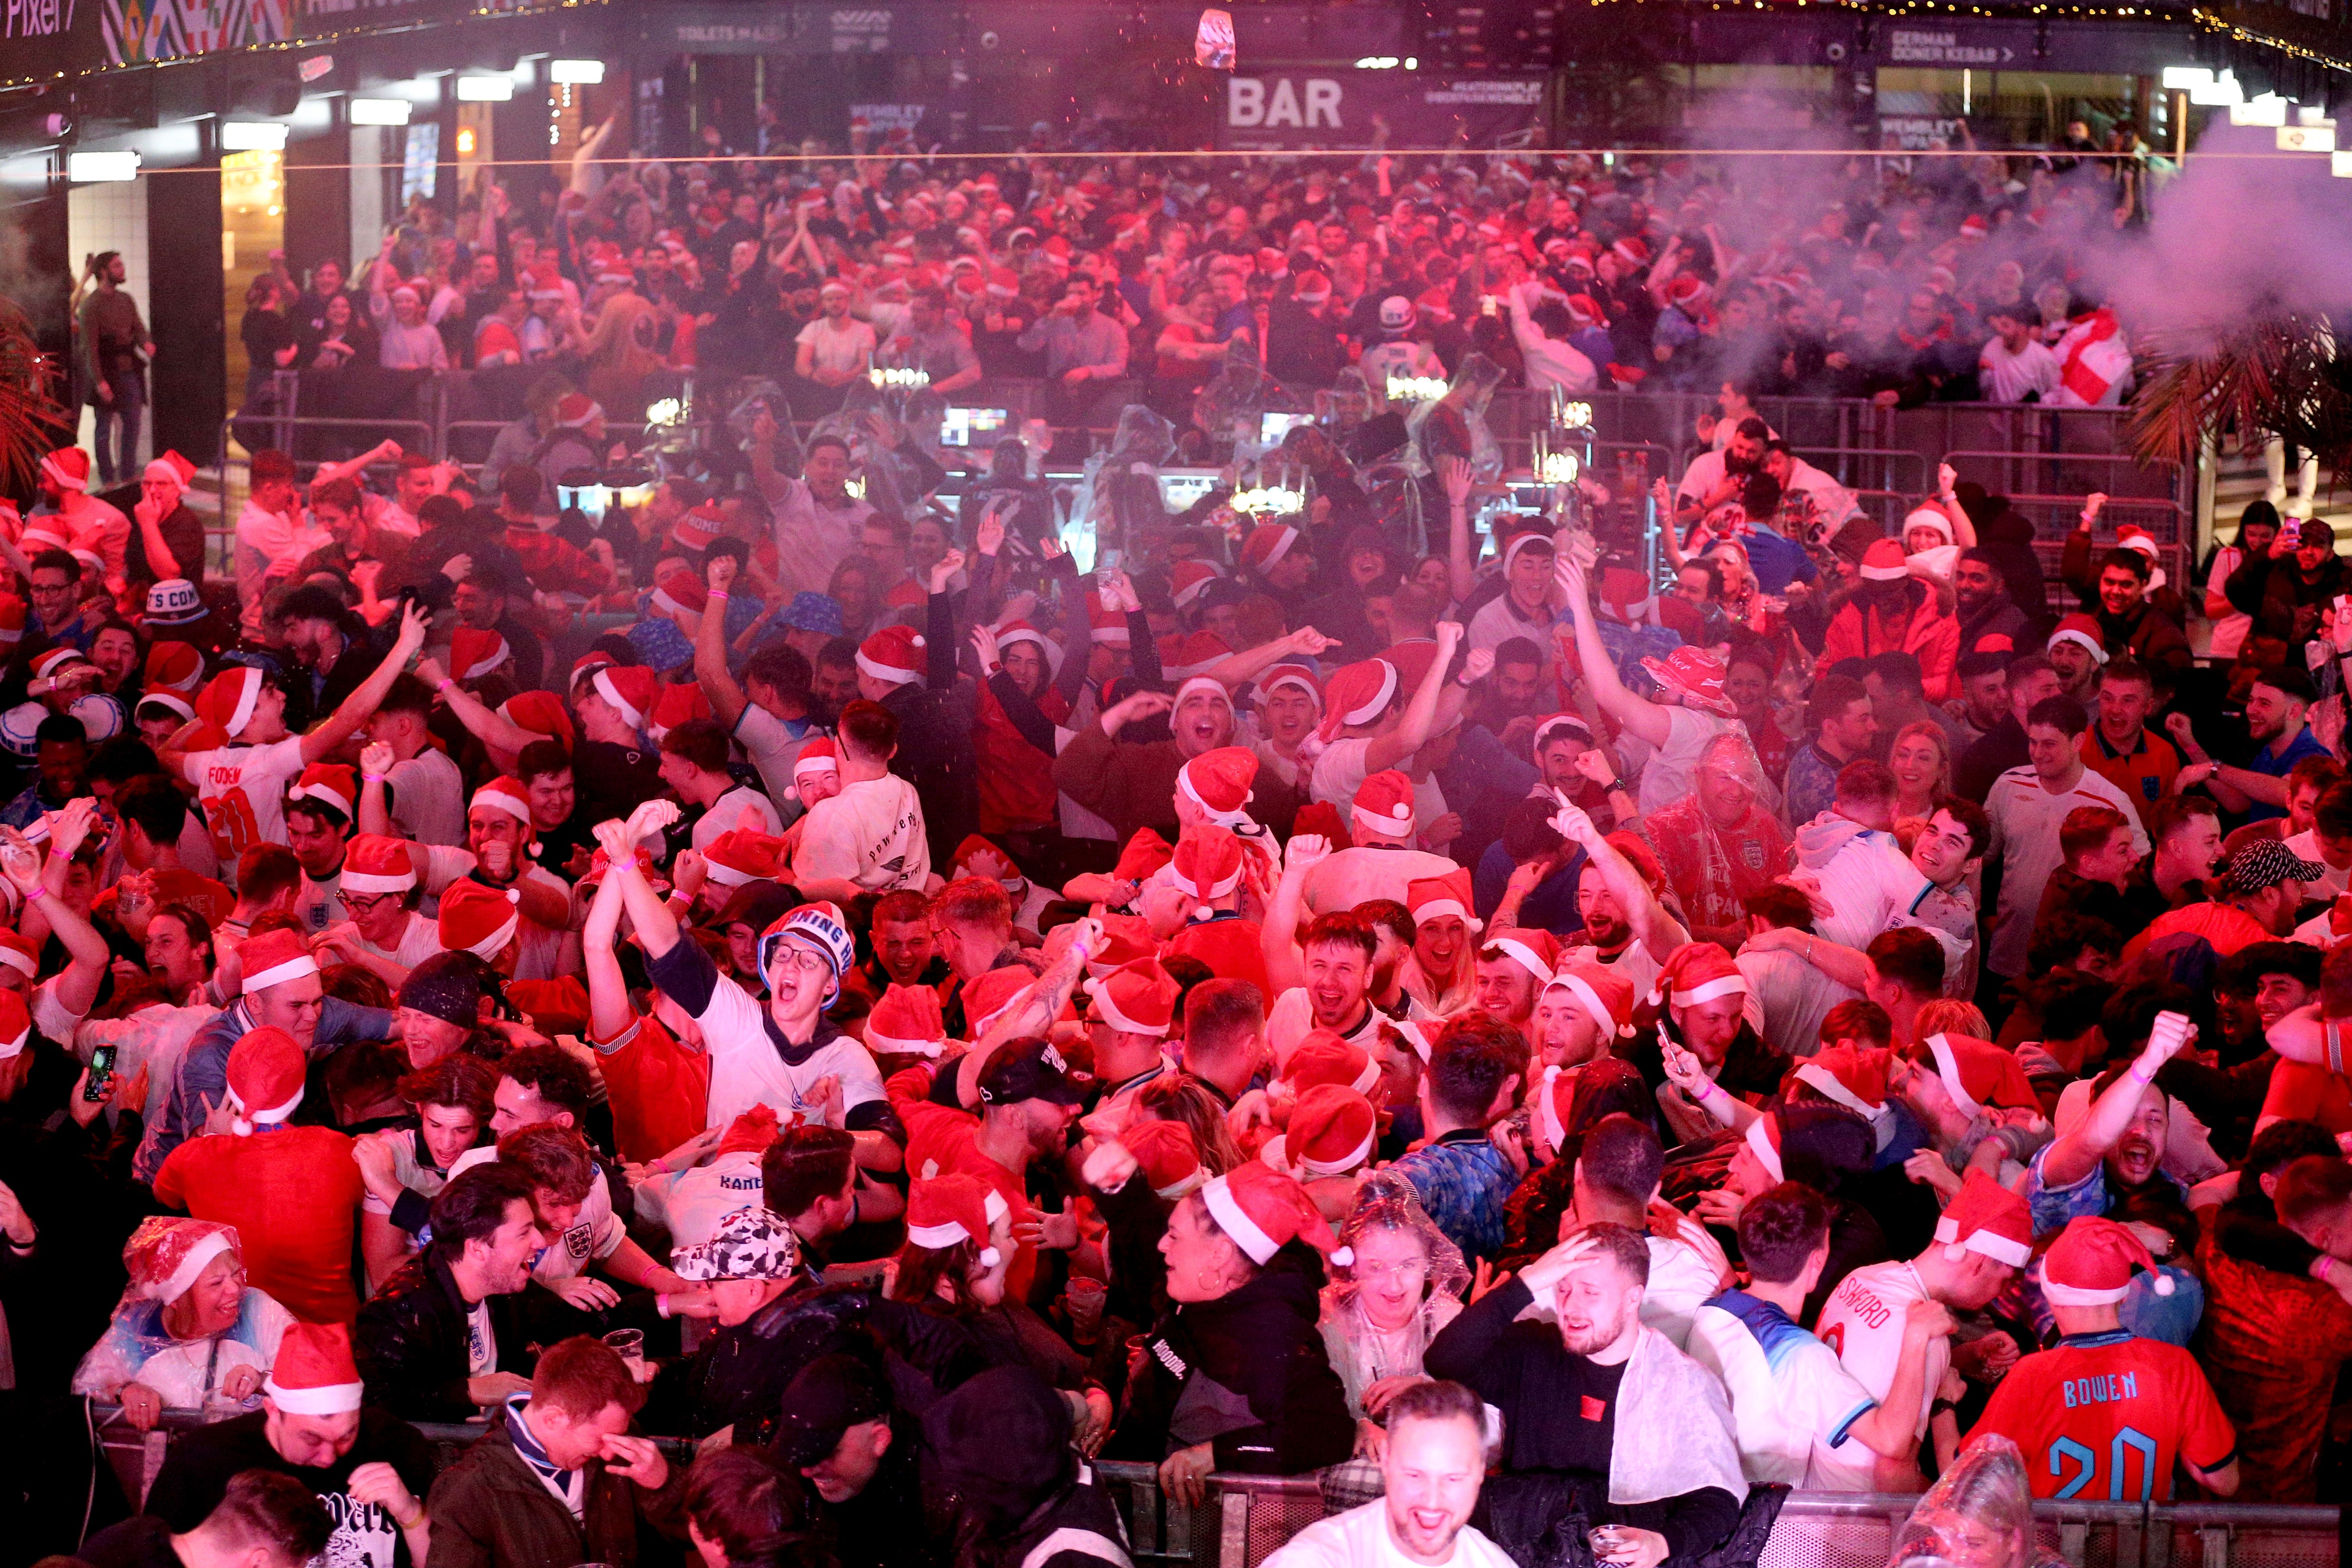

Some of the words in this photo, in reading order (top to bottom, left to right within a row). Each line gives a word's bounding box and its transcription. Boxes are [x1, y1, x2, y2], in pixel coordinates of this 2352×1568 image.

[1891, 31, 1956, 46] GERMAN
[1945, 47, 1998, 63] KEBAB
[1227, 77, 1343, 128] BAR
[1880, 119, 1957, 135] WEMBLEY
[720, 1175, 764, 1190] KANE
[2063, 1371, 2137, 1408] BOWEN
[2048, 1425, 2157, 1502] 20
